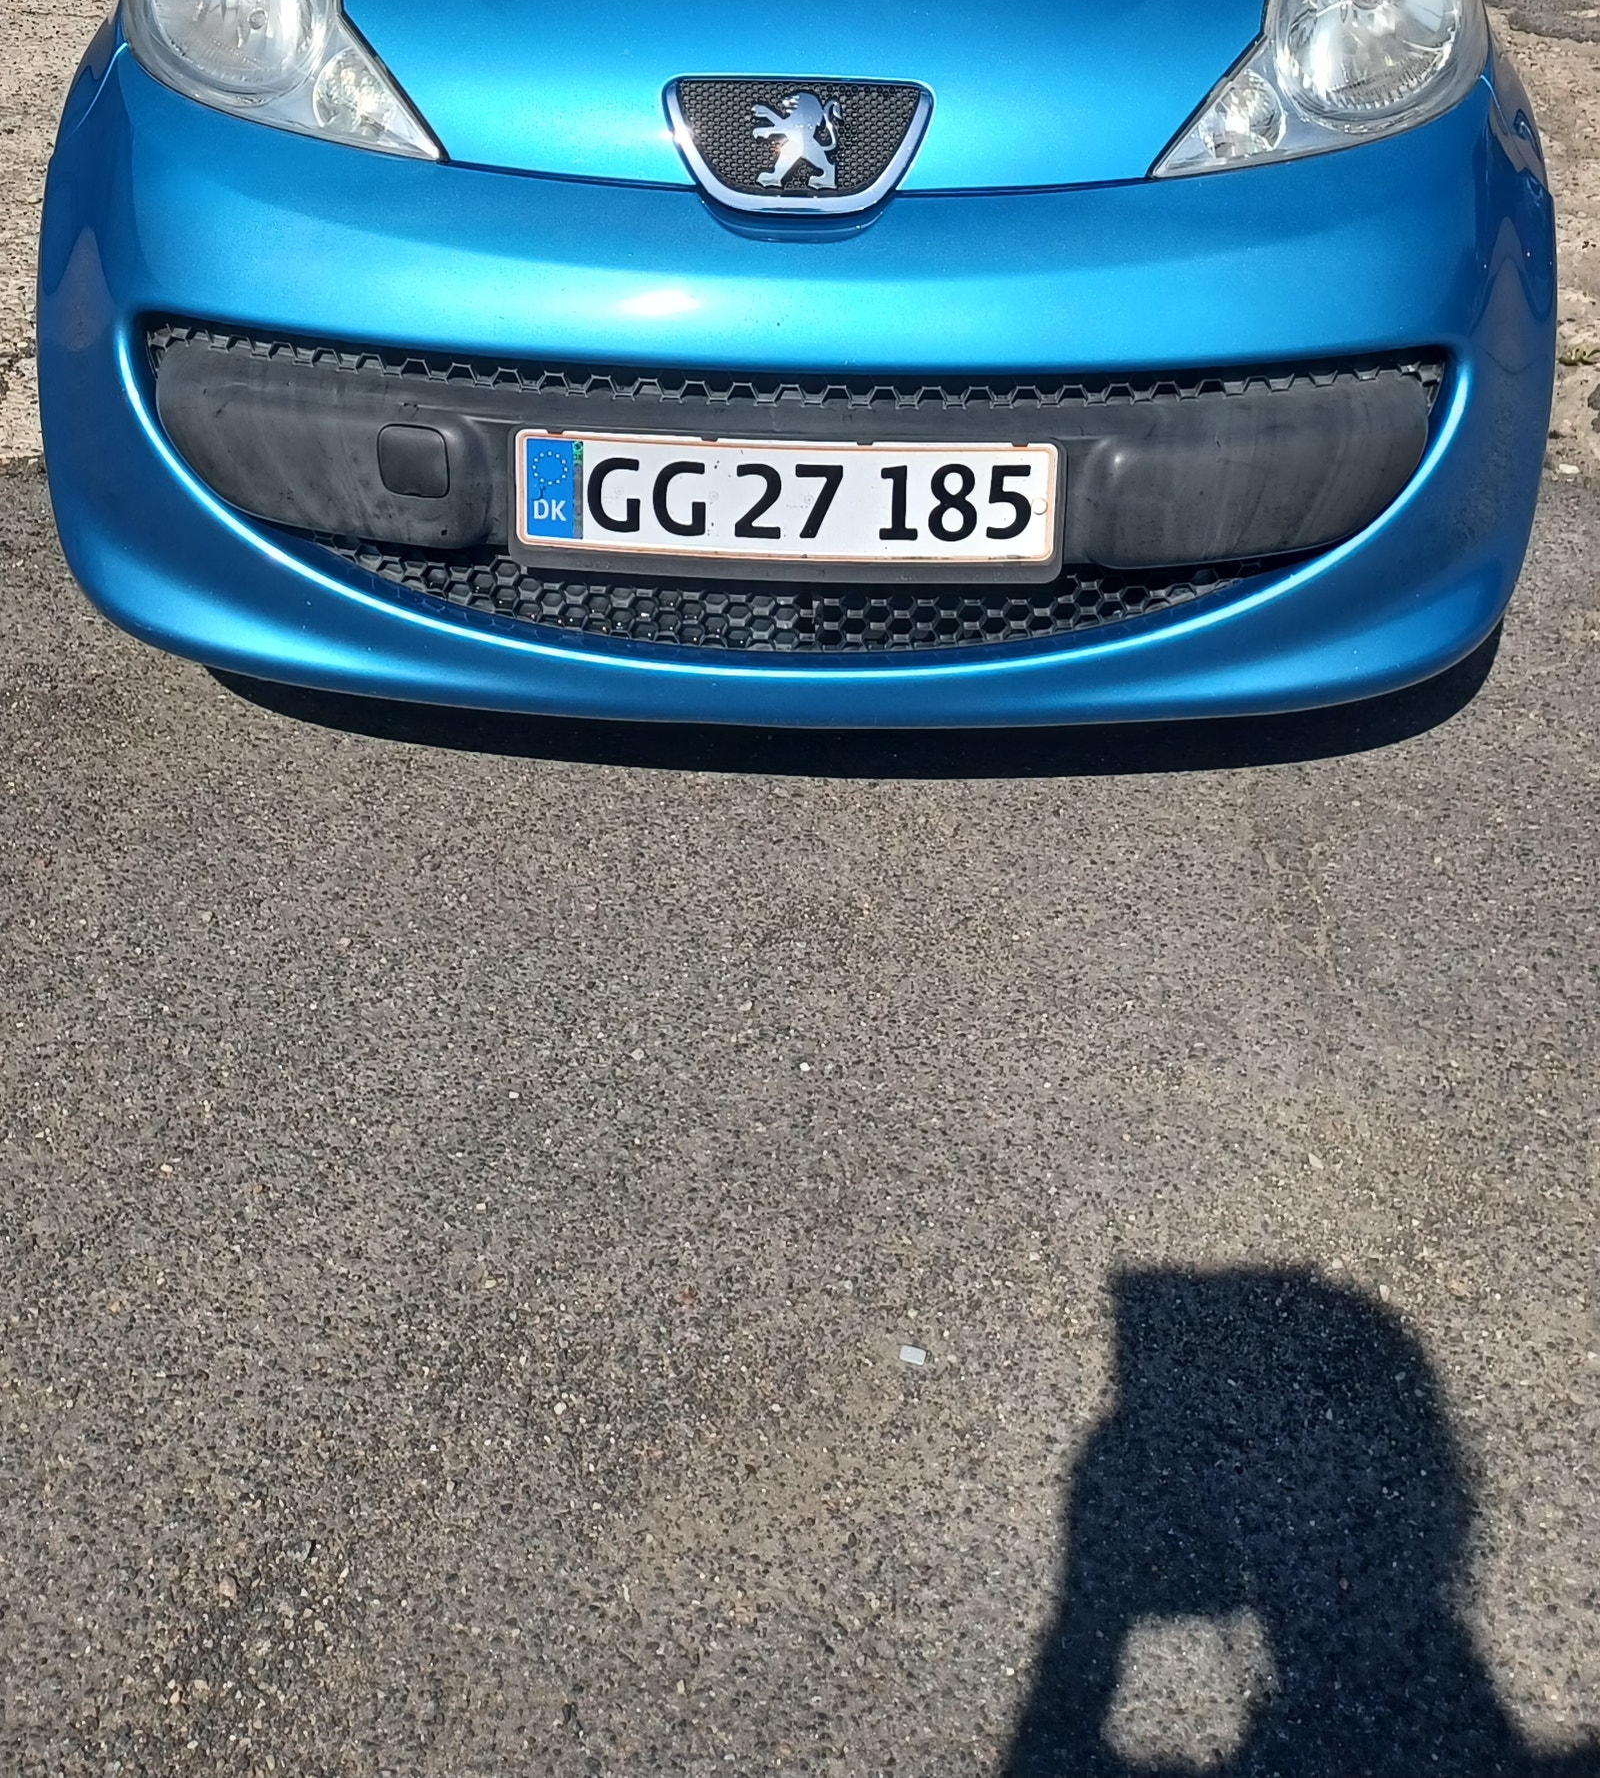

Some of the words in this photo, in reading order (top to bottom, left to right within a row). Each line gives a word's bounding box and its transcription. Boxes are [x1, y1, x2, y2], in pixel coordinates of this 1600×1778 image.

[532, 498, 567, 522] DK
[587, 457, 706, 537] GG
[734, 463, 844, 540] 27
[878, 463, 1032, 542] 185
